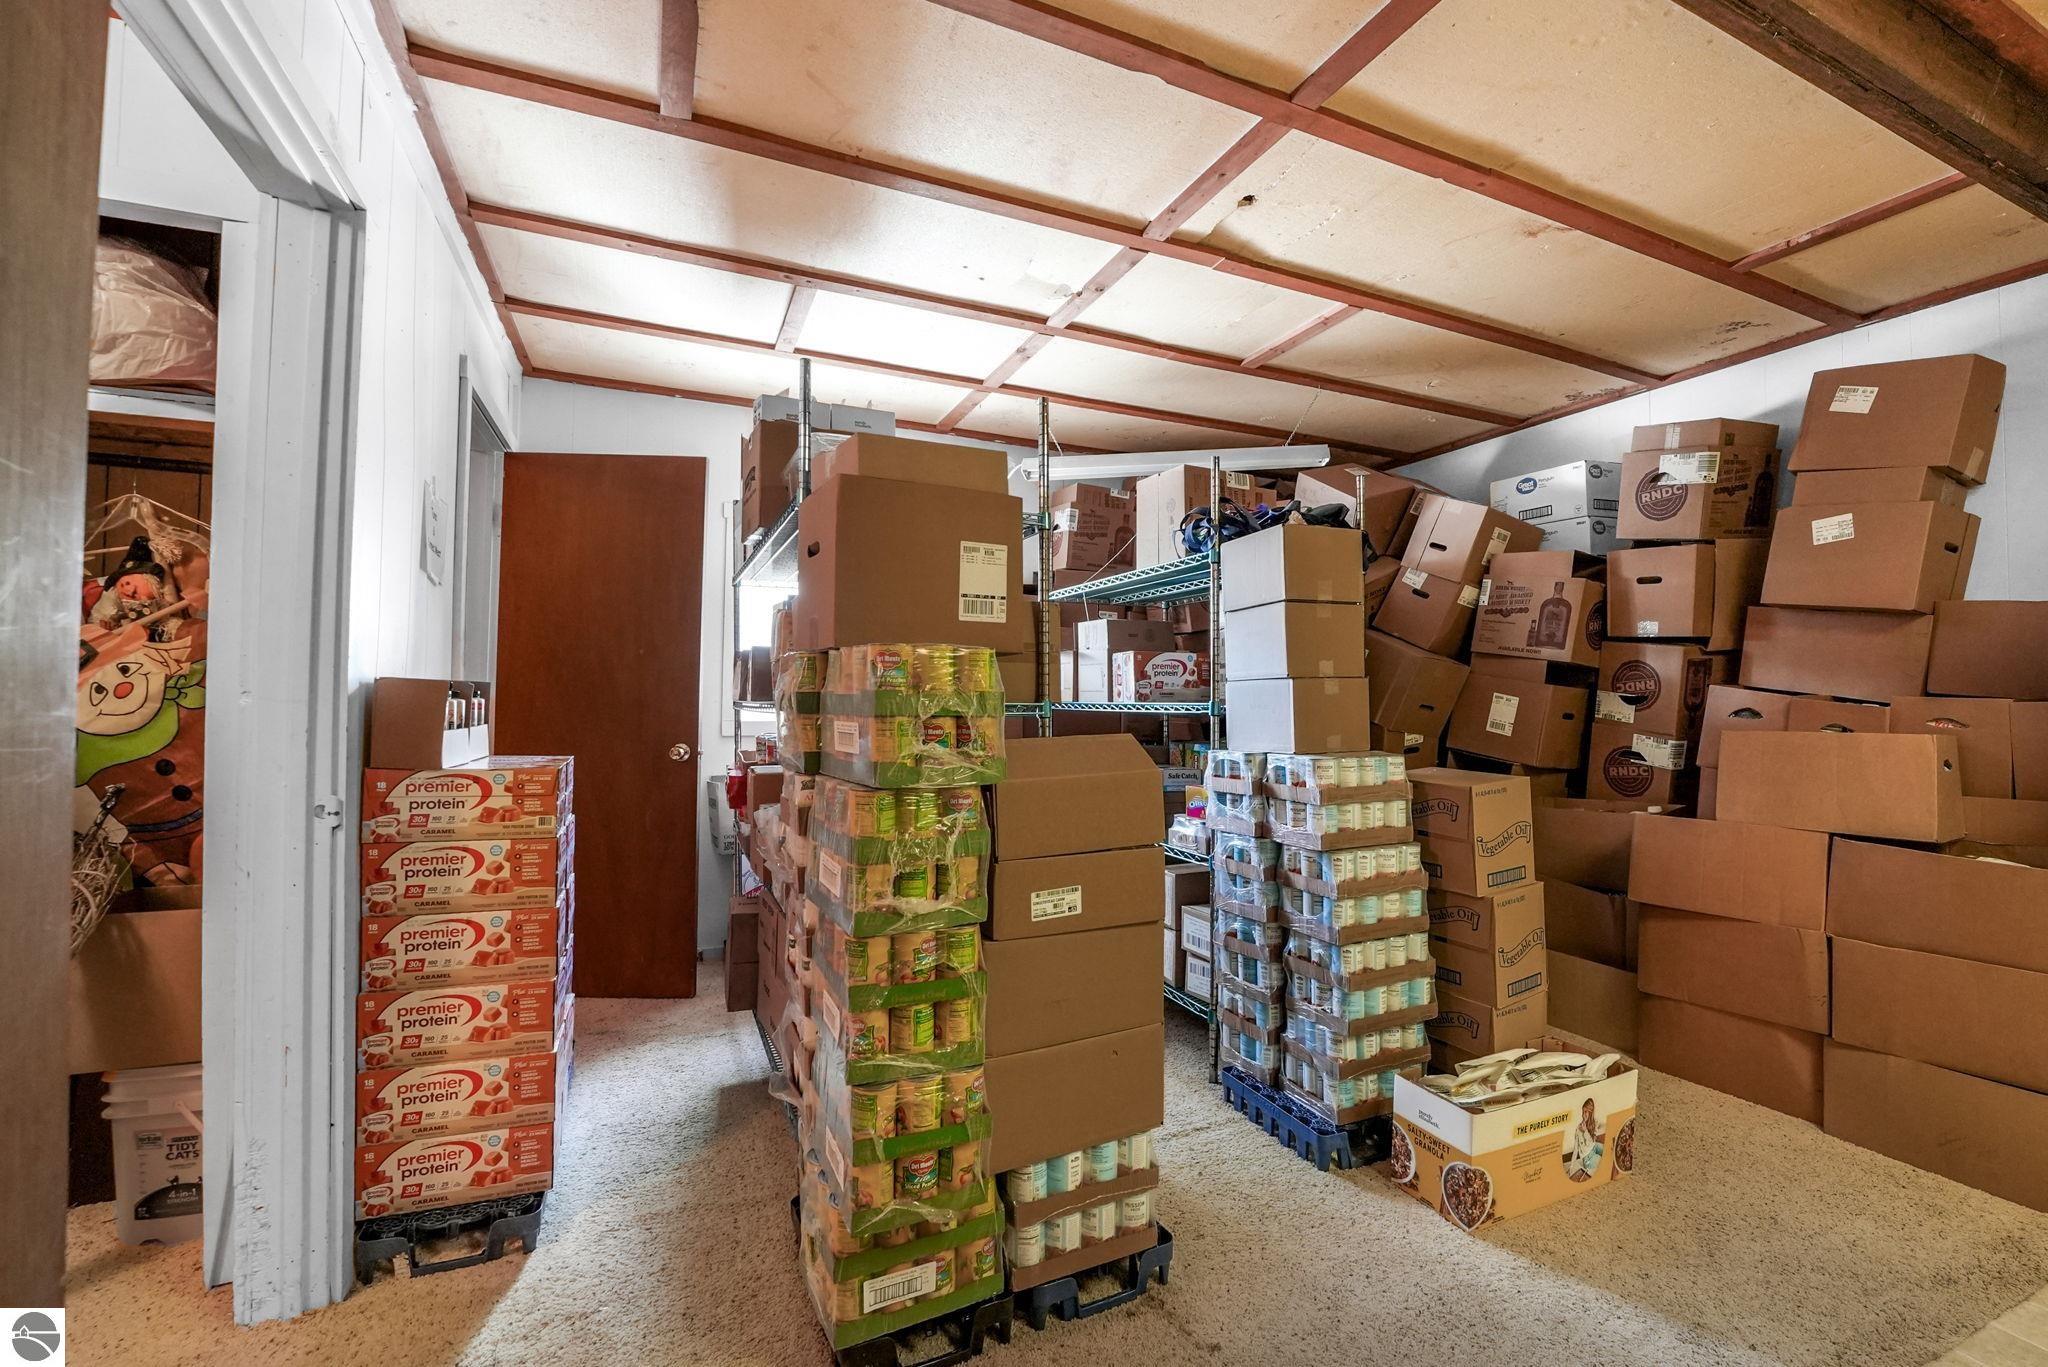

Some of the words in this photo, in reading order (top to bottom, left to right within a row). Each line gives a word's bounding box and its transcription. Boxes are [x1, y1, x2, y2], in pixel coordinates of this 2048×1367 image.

[1641, 485, 1685, 505] RNDC
[1588, 622, 1601, 632] RN
[1152, 662, 1180, 671] premier
[1154, 669, 1178, 677] protein
[1616, 679, 1657, 694] RNDC
[1181, 772, 1199, 780] Catch
[1608, 766, 1650, 777] RNDC
[405, 780, 472, 796] premier
[409, 797, 465, 813] protein
[1480, 830, 1514, 856] Vegetable
[1515, 823, 1528, 836] Oil
[400, 853, 467, 869] premier
[404, 865, 461, 881] protein
[1457, 909, 1473, 921] Oil
[400, 925, 467, 944] premier
[404, 938, 461, 956] protein
[1501, 940, 1532, 966] Vegetable
[414, 973, 451, 981] CARAMEL
[364, 1000, 375, 1008] 18
[397, 1001, 464, 1020] premier
[401, 1013, 458, 1032] protein
[1457, 1015, 1473, 1030] Oil
[411, 1049, 448, 1057] CARAMEL
[397, 1077, 465, 1098] premier
[401, 1089, 458, 1109] protein
[411, 1124, 449, 1134] CARAMEL
[1517, 1125, 1528, 1135] THE
[1529, 1120, 1551, 1132] PURELY
[1551, 1113, 1569, 1125] STORY
[166, 1141, 198, 1152] TIDY
[1407, 1123, 1450, 1155] SALTY-SWEET
[165, 1149, 200, 1161] CATS
[1414, 1137, 1445, 1160] GRANOLA
[397, 1149, 465, 1171] premier
[401, 1161, 458, 1182] protein
[168, 1187, 197, 1198] 4-in-1
[411, 1195, 449, 1206] CARAMEL
